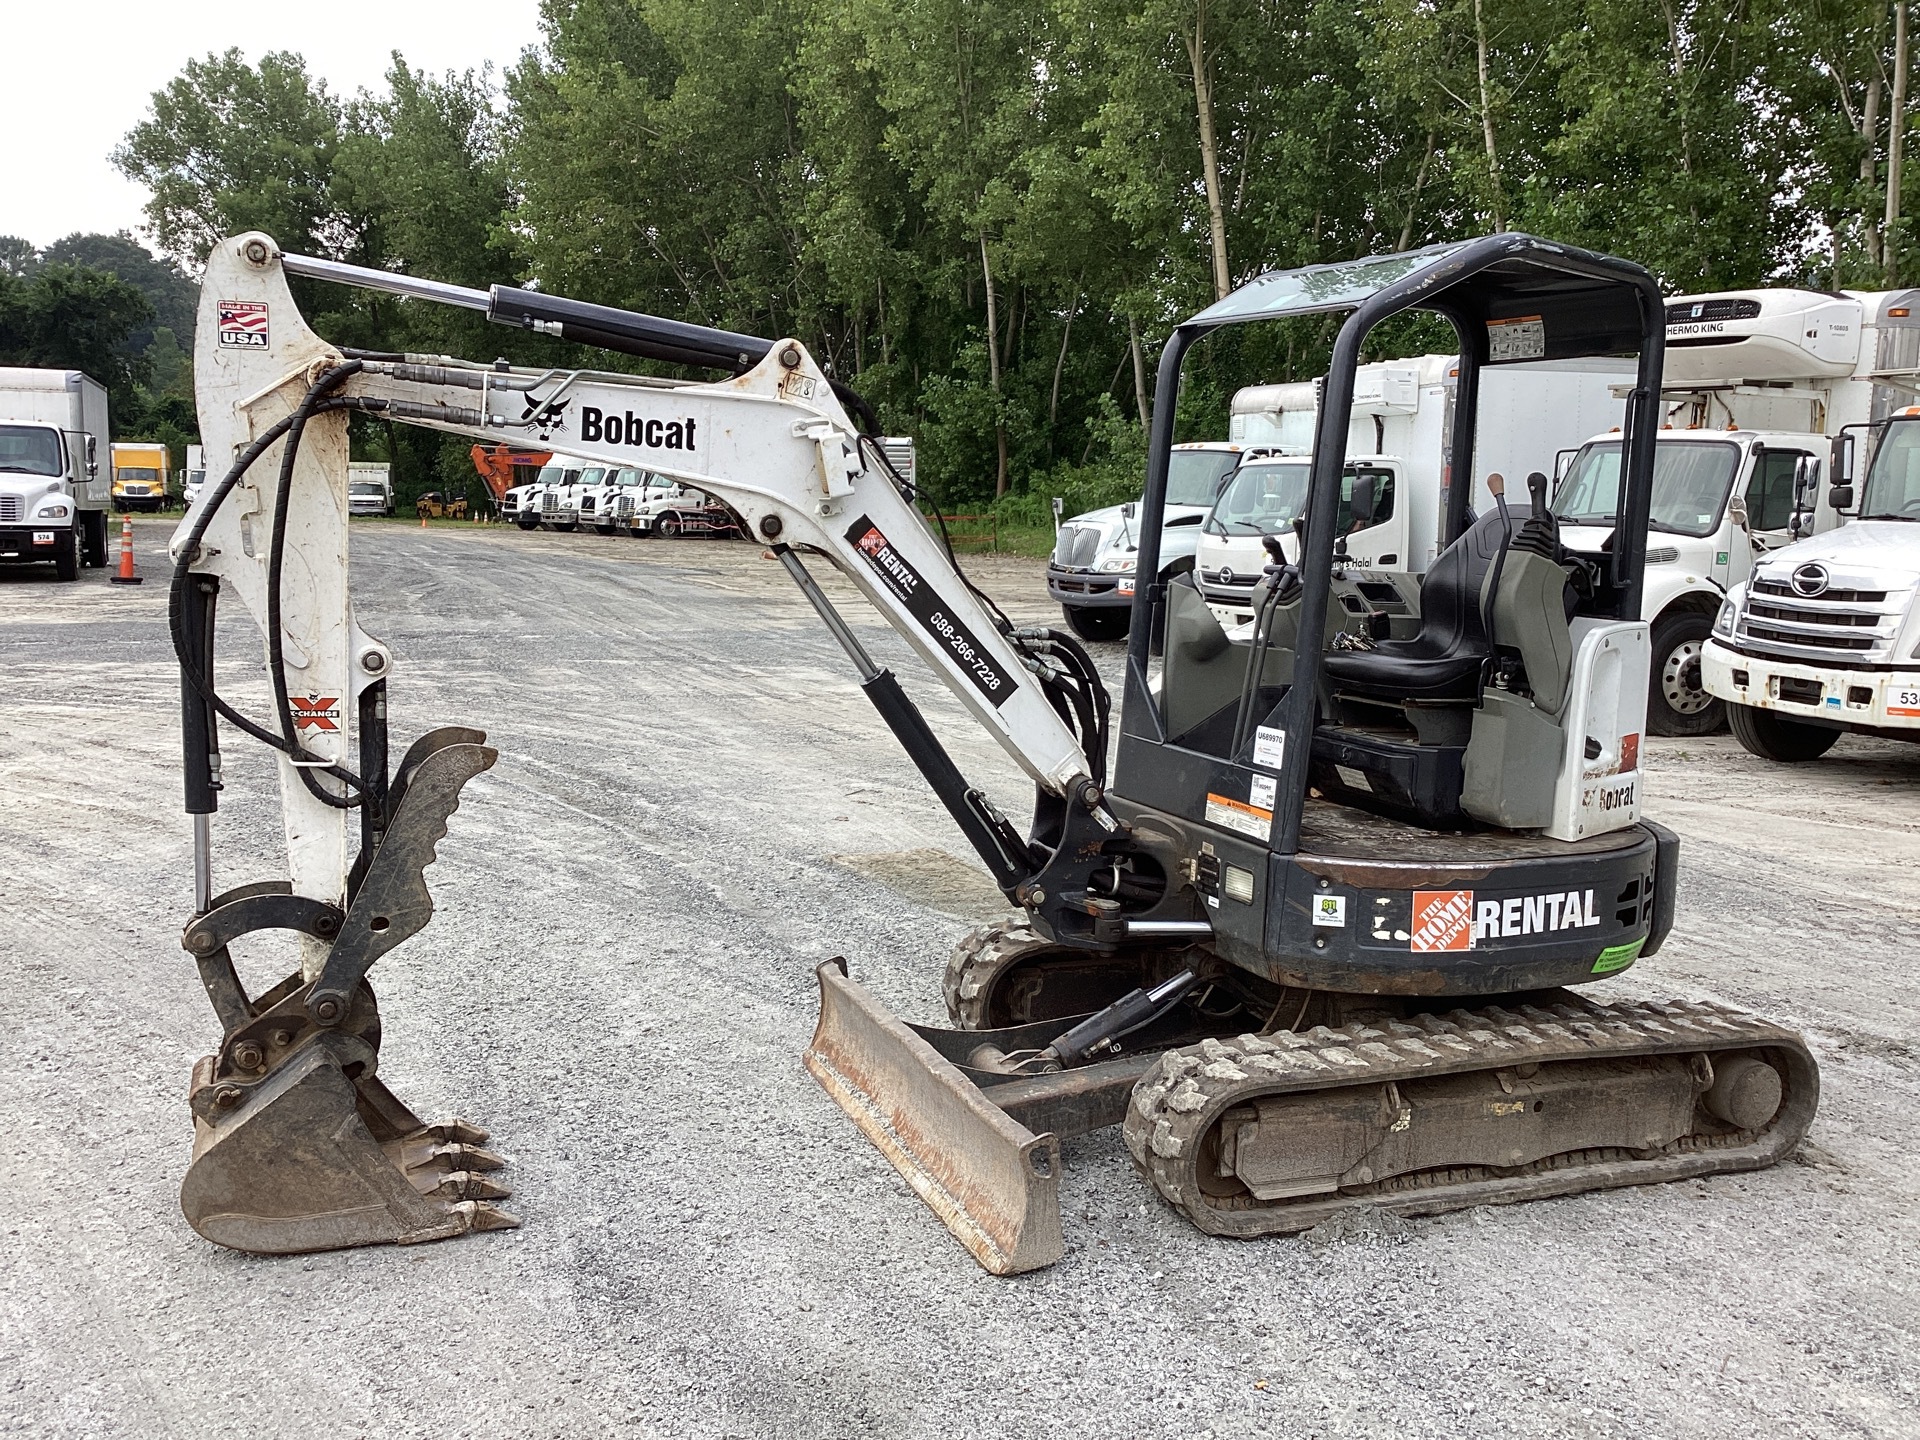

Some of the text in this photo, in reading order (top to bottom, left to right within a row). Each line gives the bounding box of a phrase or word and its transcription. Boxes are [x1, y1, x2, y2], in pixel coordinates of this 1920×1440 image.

[222, 332, 264, 344] USA
[1666, 322, 1724, 336] HERMO KING
[581, 406, 696, 451] Bobcat
[857, 546, 908, 602] homedepot.com/rental
[876, 546, 918, 595] RENTAL
[1352, 556, 1372, 568] Halal
[1124, 582, 1135, 590] 54
[930, 611, 1001, 691] 888-266-7228
[1900, 692, 1920, 705] 53
[1322, 899, 1337, 910] 811
[1419, 898, 1446, 923] THE
[1475, 889, 1600, 940] RENTAL
[1411, 891, 1472, 951] HOME
[1435, 912, 1471, 951] DEPOT
